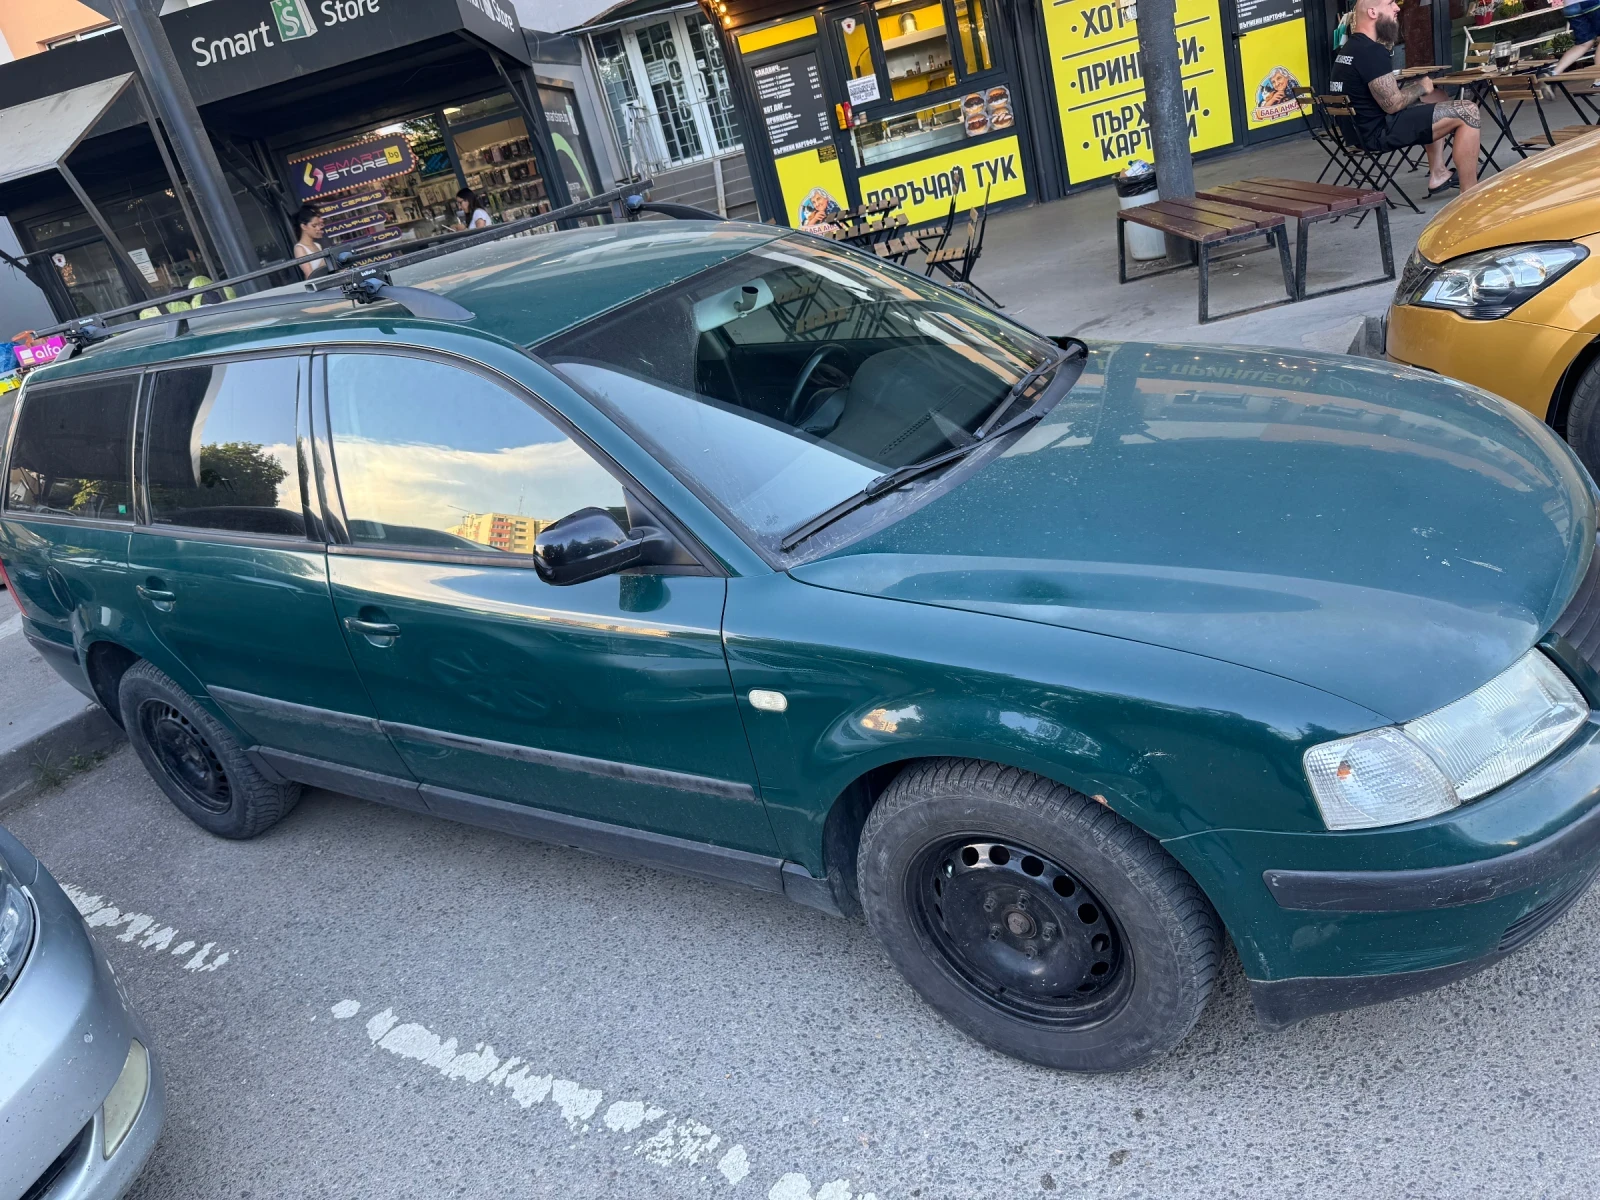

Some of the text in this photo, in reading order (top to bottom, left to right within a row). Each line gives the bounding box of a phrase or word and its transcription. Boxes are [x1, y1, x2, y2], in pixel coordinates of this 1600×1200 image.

[191, 21, 275, 67] Smart
[320, 0, 380, 27] Store
[662, 41, 692, 120] ФОТО
[1077, 36, 1199, 94] ПРИНИ
[1260, 108, 1279, 117] БАБА
[323, 149, 384, 171] SMART
[1100, 114, 1198, 161] КАРТИ
[325, 157, 389, 181] STORE
[867, 154, 1018, 217] ПОРЪЧАЙ ТУК
[341, 192, 381, 207] СЕРВИЗ
